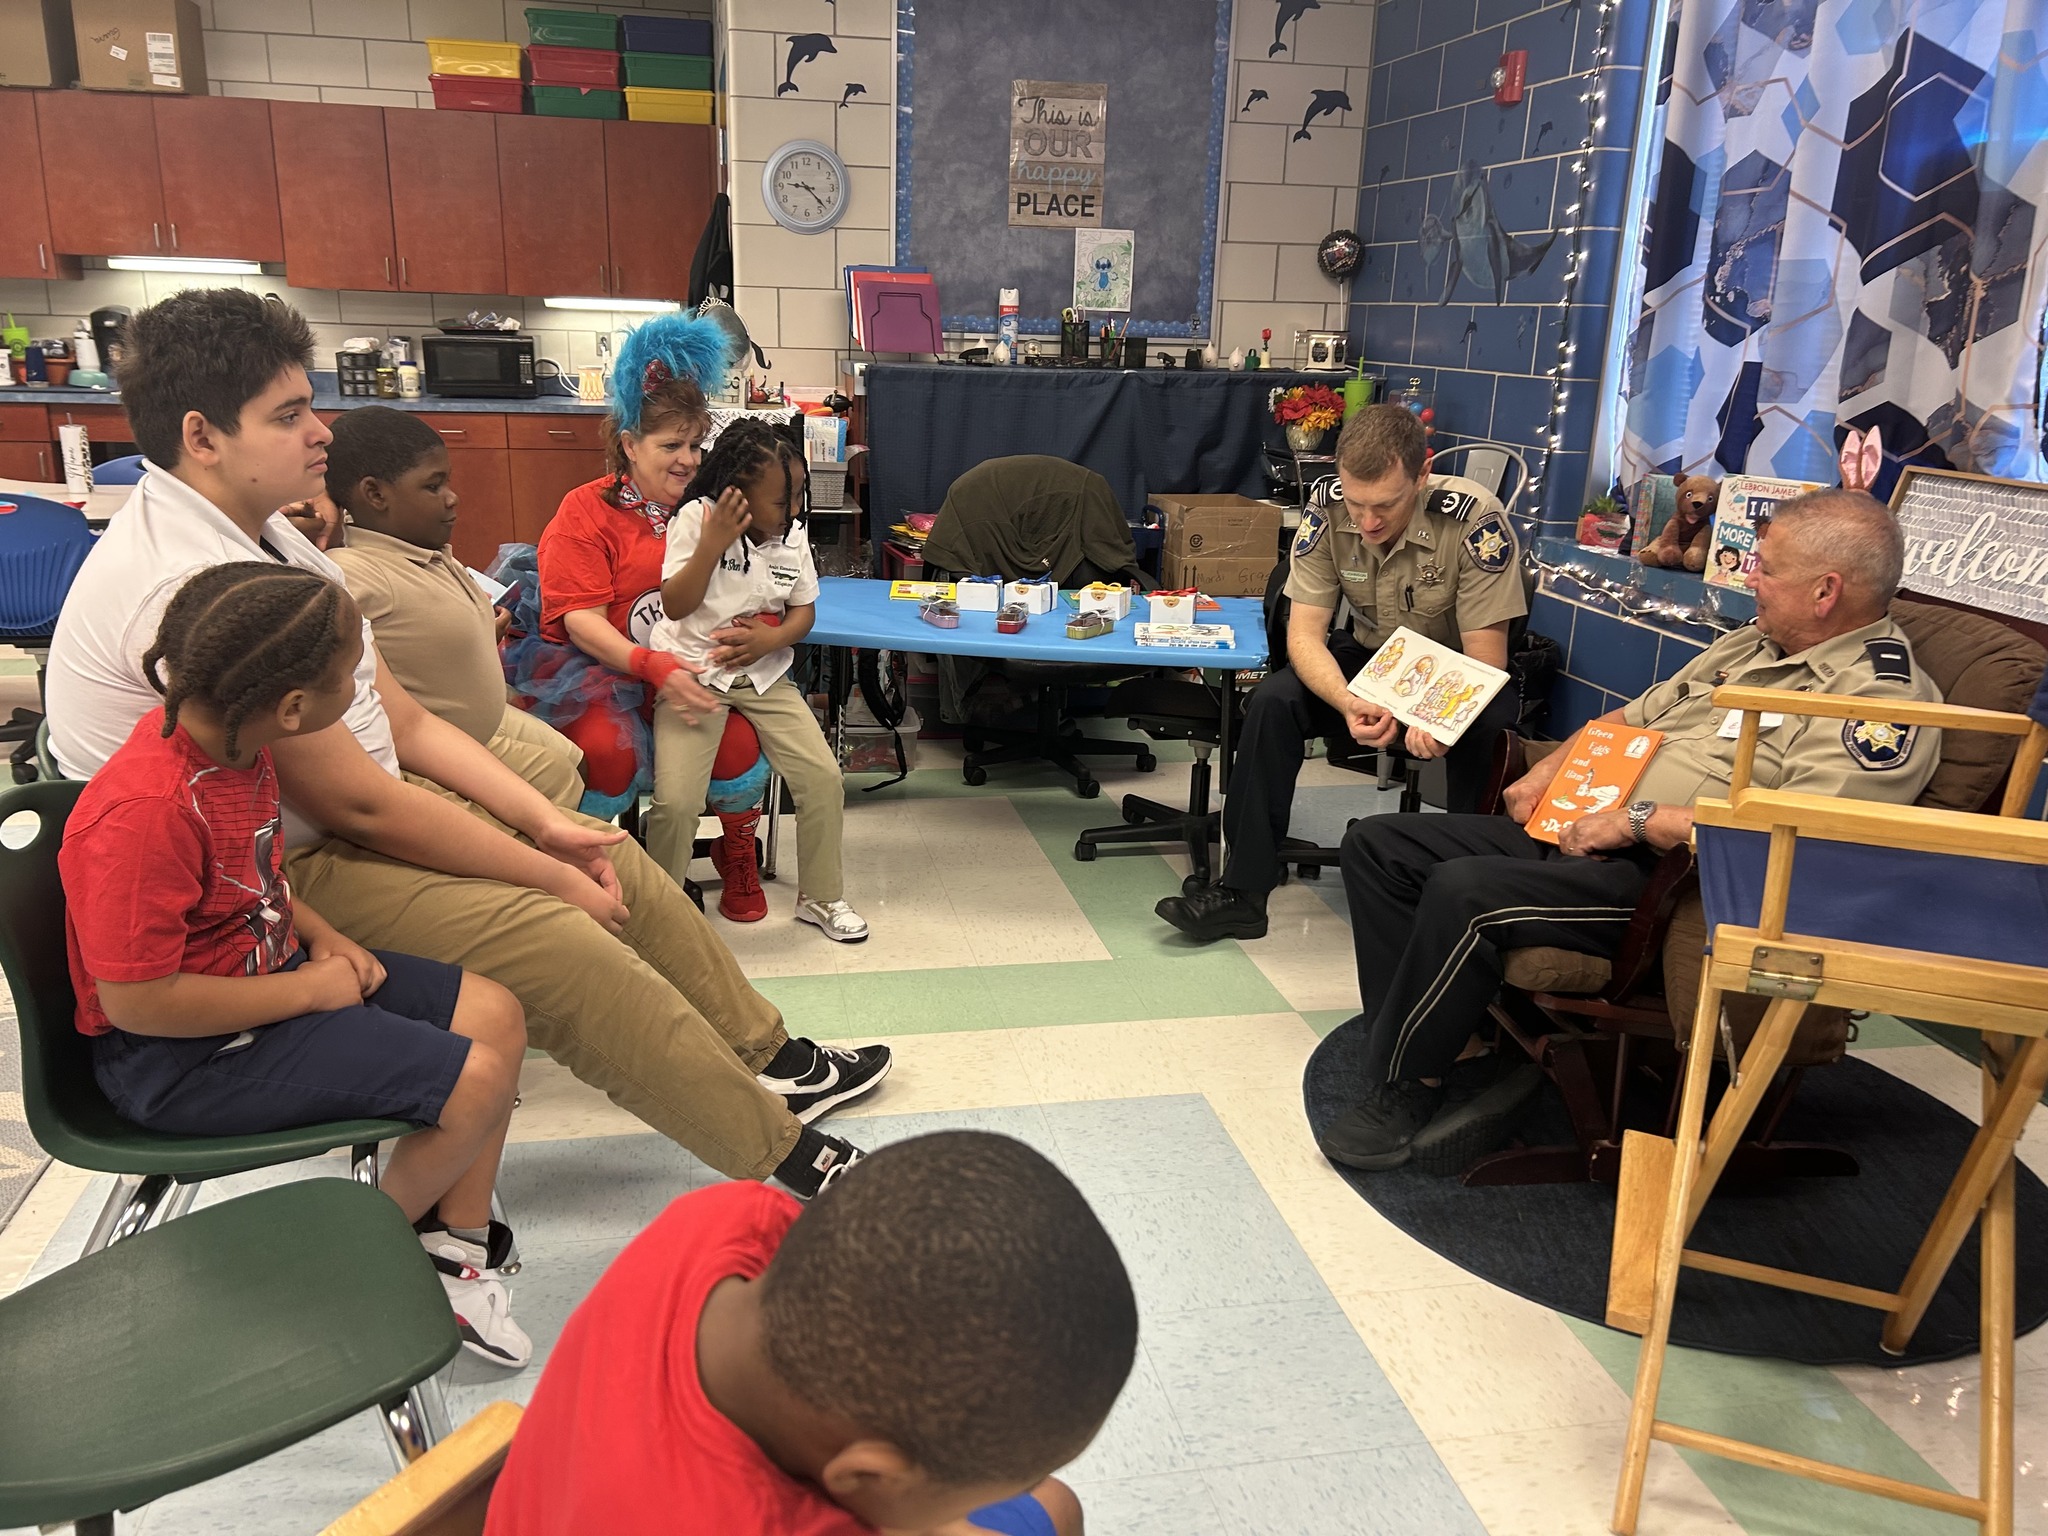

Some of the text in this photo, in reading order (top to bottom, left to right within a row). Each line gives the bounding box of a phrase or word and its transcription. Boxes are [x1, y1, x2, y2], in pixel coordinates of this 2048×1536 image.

[1018, 96, 1100, 127] This is
[1023, 127, 1093, 158] OUR
[790, 161, 799, 170] 11
[802, 157, 811, 166] 12
[782, 171, 792, 179] 10
[826, 171, 831, 180] 2
[1017, 160, 1097, 192] happy
[778, 182, 784, 190] 9
[829, 184, 835, 192] 3
[782, 195, 788, 203] 8
[826, 196, 832, 205] 4
[792, 205, 798, 214] 7
[1016, 192, 1095, 217] PLACE
[804, 208, 810, 217] 6
[817, 206, 823, 215] 5
[1740, 481, 1770, 494] LEBRON
[1772, 487, 1797, 497] JAMES
[1749, 501, 1758, 516] I
[1719, 525, 1754, 548] MORE
[1197, 570, 1225, 585] Mardi
[1588, 727, 1614, 739] Green
[1588, 741, 1612, 757] Eggs
[1572, 757, 1590, 767] and
[1564, 769, 1585, 781] Ham
